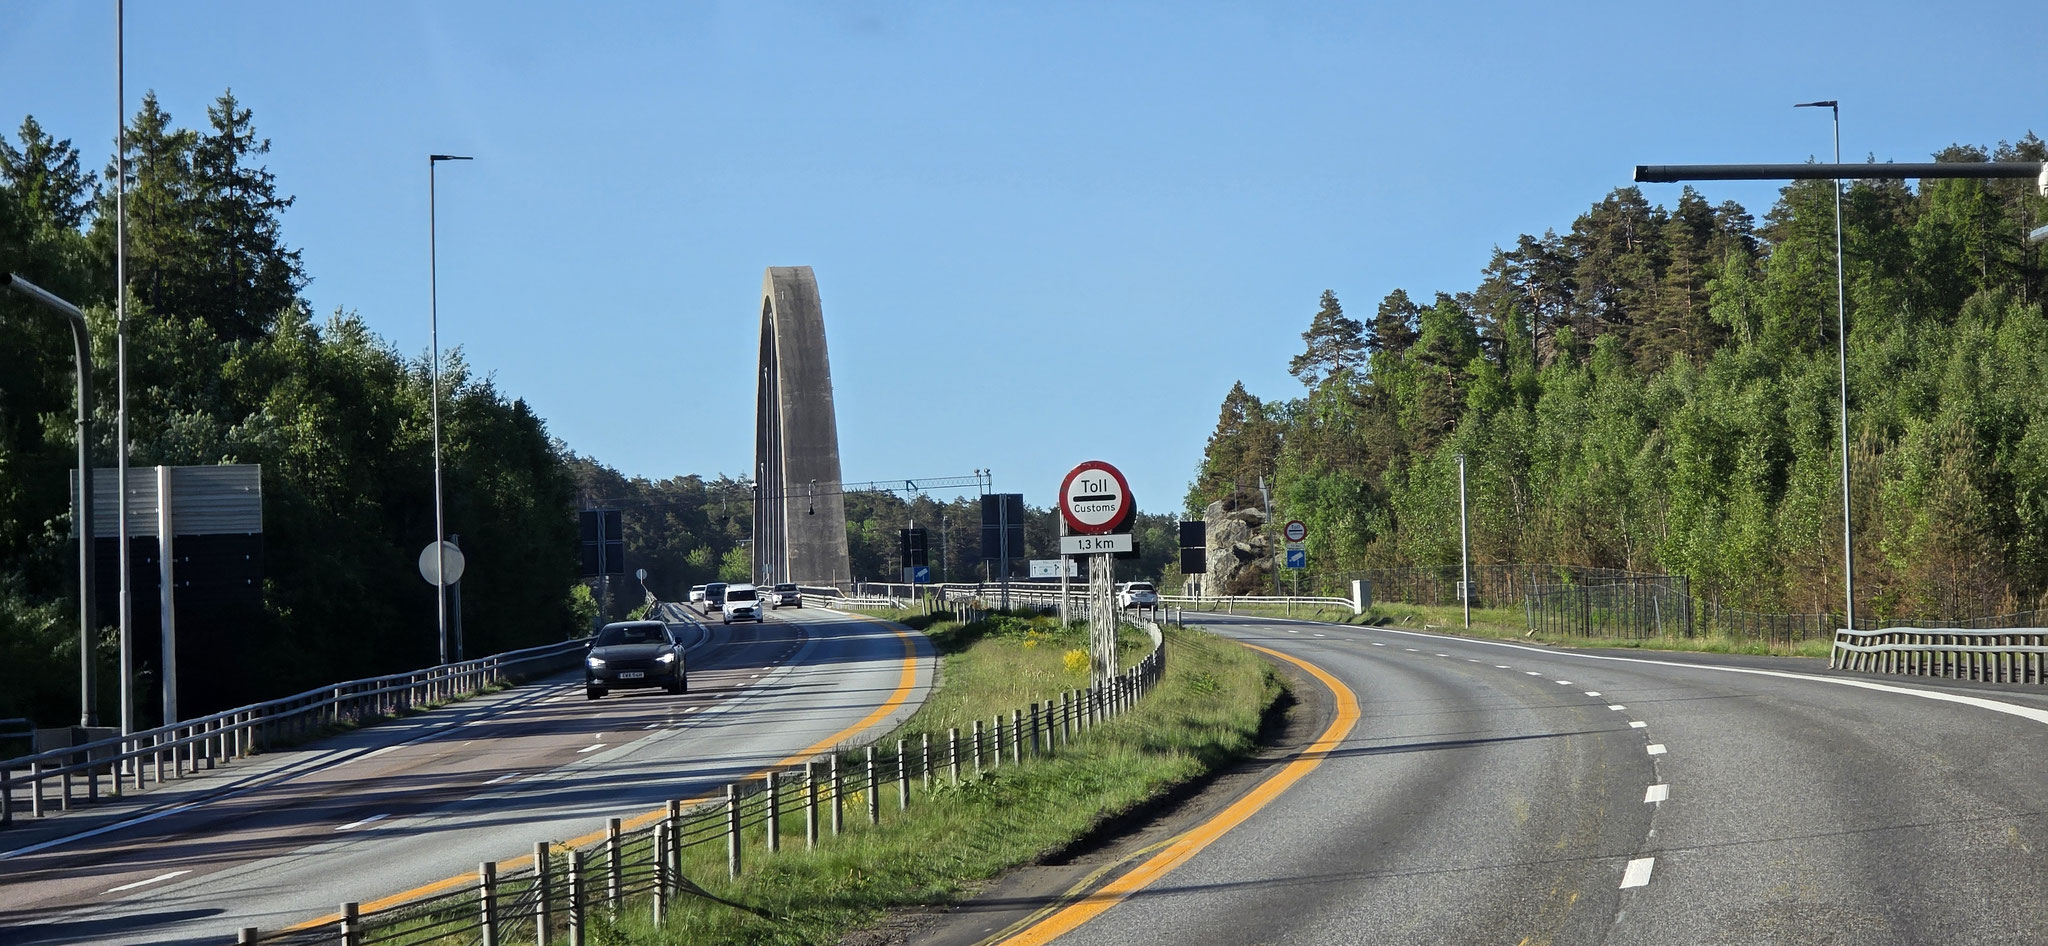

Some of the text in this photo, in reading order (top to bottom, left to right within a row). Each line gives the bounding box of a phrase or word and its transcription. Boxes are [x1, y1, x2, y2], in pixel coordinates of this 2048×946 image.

[1081, 479, 1107, 493] Toll
[1074, 504, 1116, 513] Customs
[1078, 538, 1114, 550] 1,3 km
